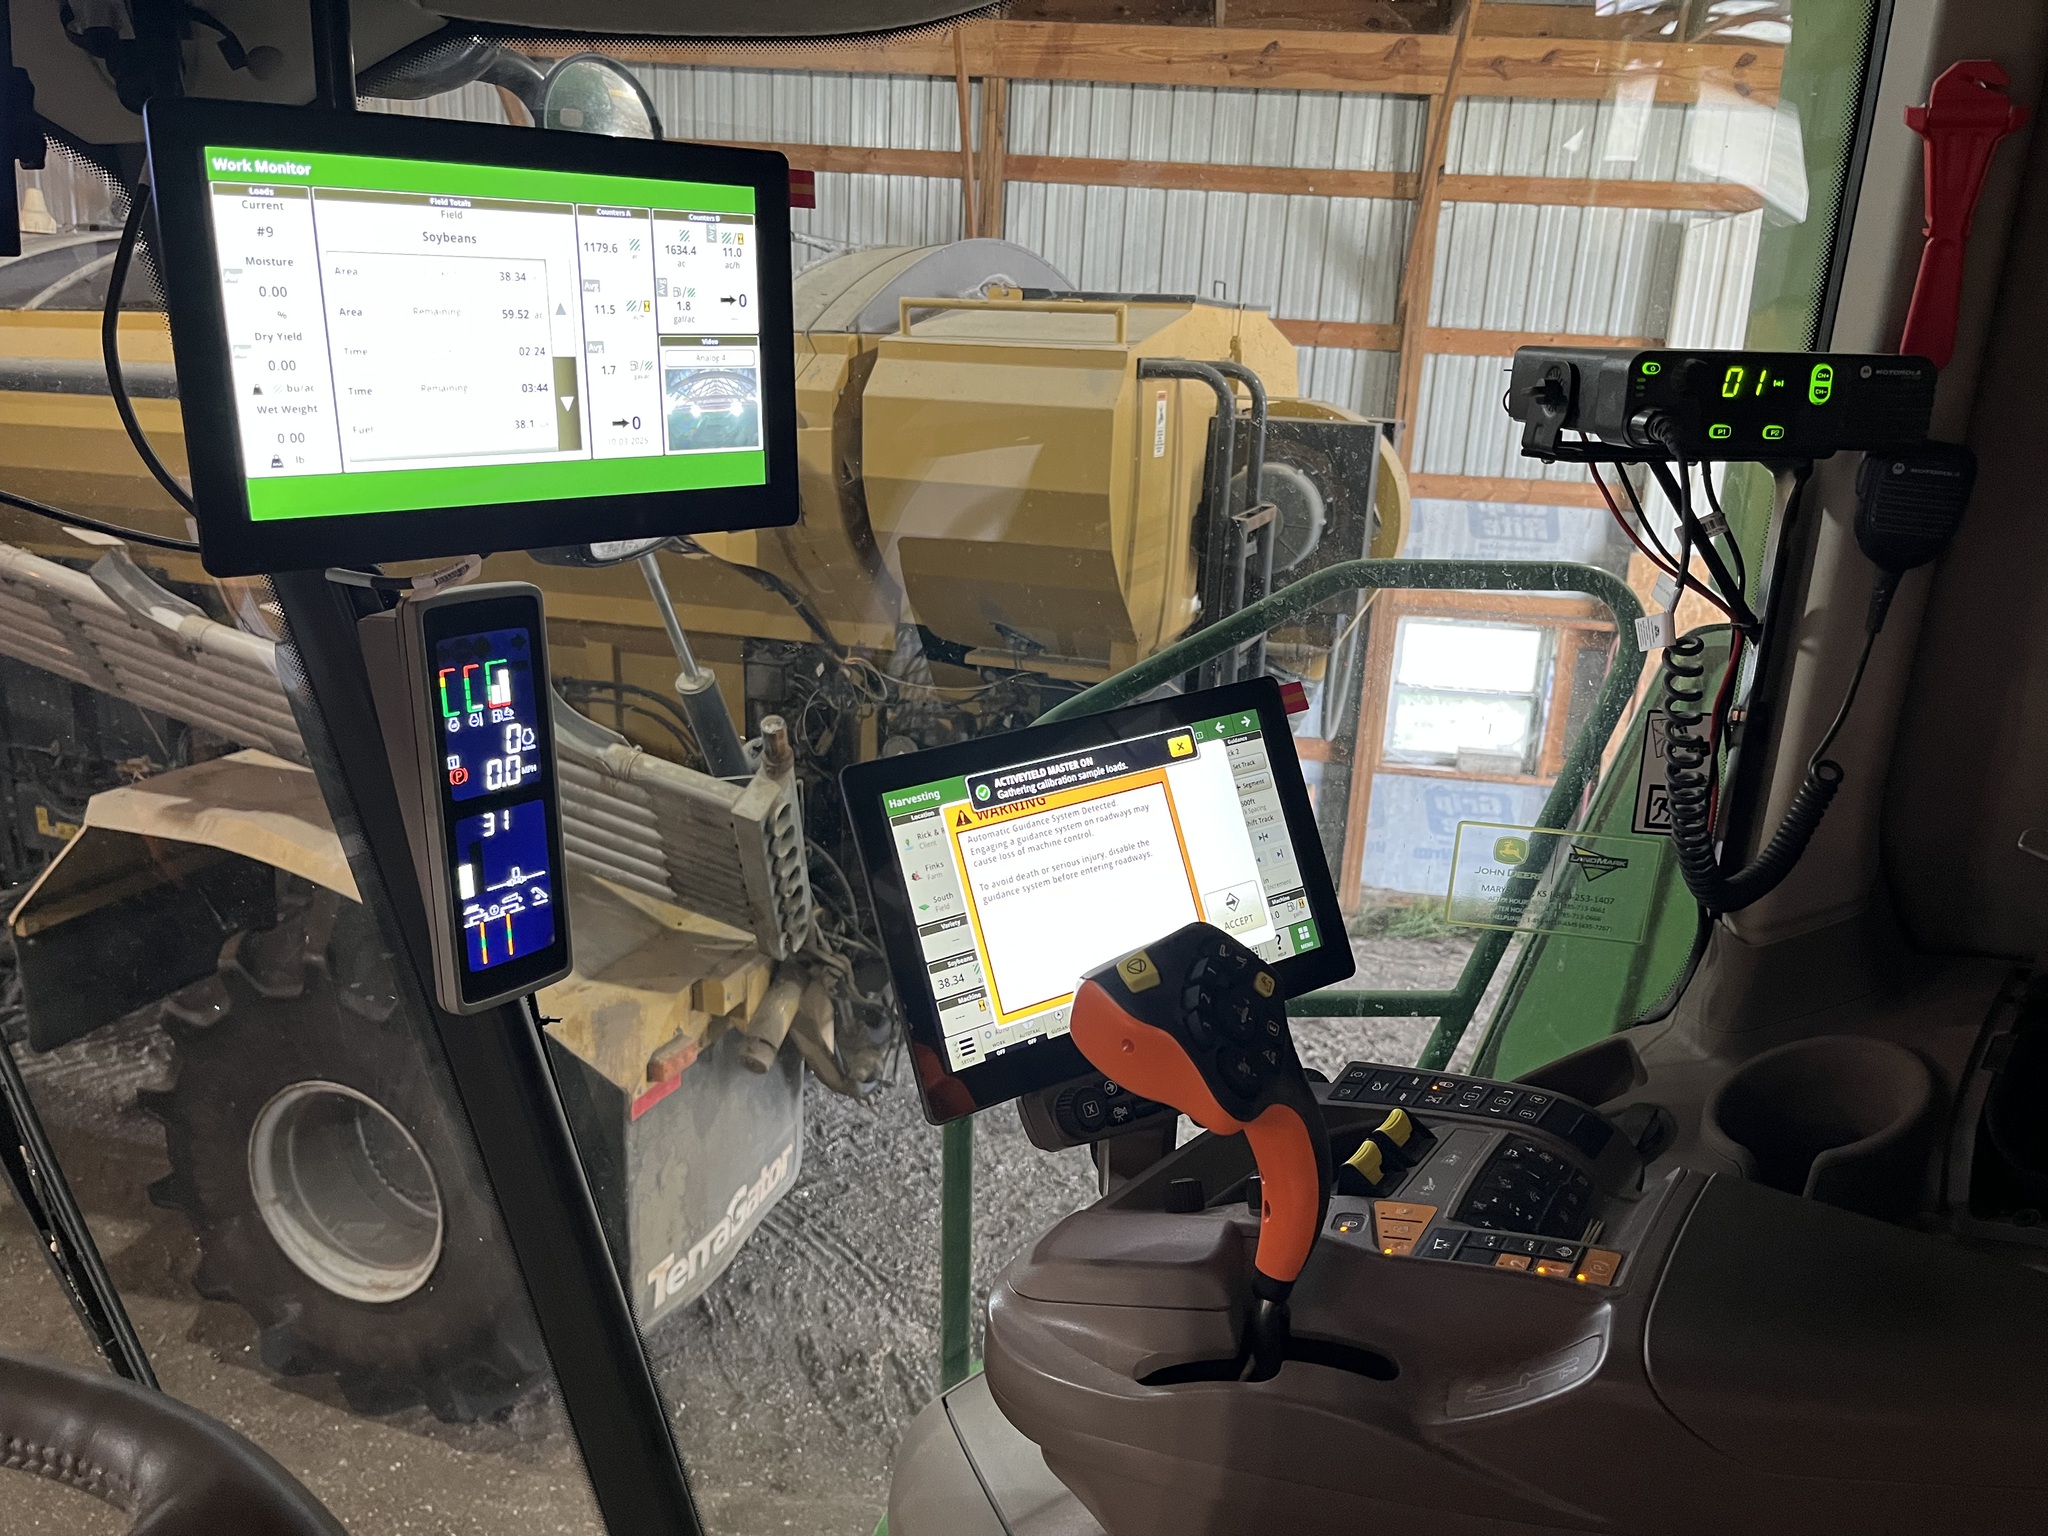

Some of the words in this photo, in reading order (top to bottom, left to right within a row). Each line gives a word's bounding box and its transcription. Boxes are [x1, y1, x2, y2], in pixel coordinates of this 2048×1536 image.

[212, 157, 252, 173] Work
[255, 160, 311, 176] Monitor
[249, 187, 274, 196] Loads
[242, 200, 284, 211] Current
[429, 197, 448, 207] Field
[449, 198, 471, 208] Totals
[440, 210, 463, 219] Field
[597, 208, 625, 216] Counters
[688, 213, 715, 221] Counters
[257, 226, 274, 238] #9
[422, 231, 477, 245] Soybeans
[584, 242, 618, 253] 1179.6
[665, 245, 697, 256] 1634.4
[723, 247, 742, 258] 11.0
[245, 256, 294, 266] Moisture
[334, 267, 358, 276] Area
[499, 272, 526, 281] 38.34
[259, 286, 288, 298] 0.00
[595, 304, 616, 315] 11.5
[677, 301, 691, 311] 1.8
[339, 307, 363, 317] Area
[502, 310, 530, 319] 59.52
[254, 332, 274, 343] Dry
[277, 332, 303, 341] Yield
[268, 360, 296, 371] 0.00
[602, 365, 616, 375] 1.7
[522, 384, 548, 392] 03:44
[1722, 367, 1767, 398] 01
[348, 387, 373, 395] Time
[257, 405, 278, 414] Wet
[281, 405, 318, 415] Weight
[515, 420, 534, 429] 38.1
[277, 433, 305, 443] 000
[295, 455, 305, 463] lb
[1047, 762, 1080, 775] MASTER
[1080, 757, 1093, 767] ON
[486, 755, 521, 790] 0.0
[522, 764, 537, 774] MPH
[997, 780, 1037, 799] Gathering
[1037, 773, 1077, 790] calibration
[1078, 766, 1105, 781] sample
[1106, 761, 1128, 773] loads.
[1243, 779, 1265, 788] Segment
[888, 790, 941, 809] Harvesting
[976, 797, 1046, 821] WARNING
[1248, 805, 1267, 814] Spacing
[910, 811, 935, 821] Location
[967, 827, 1011, 844] Automatic
[1012, 816, 1050, 832] Guidance
[1051, 810, 1080, 823] System
[1081, 799, 1119, 815] Detected.
[1259, 815, 1274, 823] Track
[917, 830, 933, 840] Rick
[970, 840, 1008, 856] Engaging
[1016, 830, 1053, 847] guidance
[1055, 821, 1083, 835] system
[1084, 819, 1095, 827] on
[1096, 808, 1132, 823] roadways
[1134, 804, 1150, 815] may
[919, 840, 938, 850] Client
[974, 857, 997, 867] cause
[999, 849, 1016, 862] loss
[1017, 847, 1026, 856] of
[1028, 838, 1061, 853] machine
[1063, 830, 1095, 844] control.
[924, 861, 944, 872] Finks
[979, 882, 989, 891] To
[992, 875, 1014, 886] avoid
[1016, 868, 1039, 882] death
[1052, 859, 1081, 872] serious
[1108, 843, 1135, 856] disable
[1137, 839, 1150, 849] the
[926, 872, 943, 881] Farm
[1475, 866, 1505, 876] JOHN
[983, 886, 1020, 905] guidance
[1022, 878, 1051, 894] system
[1052, 871, 1078, 884] before
[1080, 861, 1114, 876] entering
[1115, 852, 1153, 866] roadways.
[1267, 879, 1292, 890] Increment
[933, 892, 954, 903] South
[1271, 896, 1291, 905] Machine
[935, 903, 950, 913] Field
[940, 919, 961, 930] Variety
[1224, 914, 1253, 930] ACCEPT
[947, 955, 974, 968] Soybeans
[938, 974, 965, 990] 38.34
[958, 992, 982, 1004] Machine
